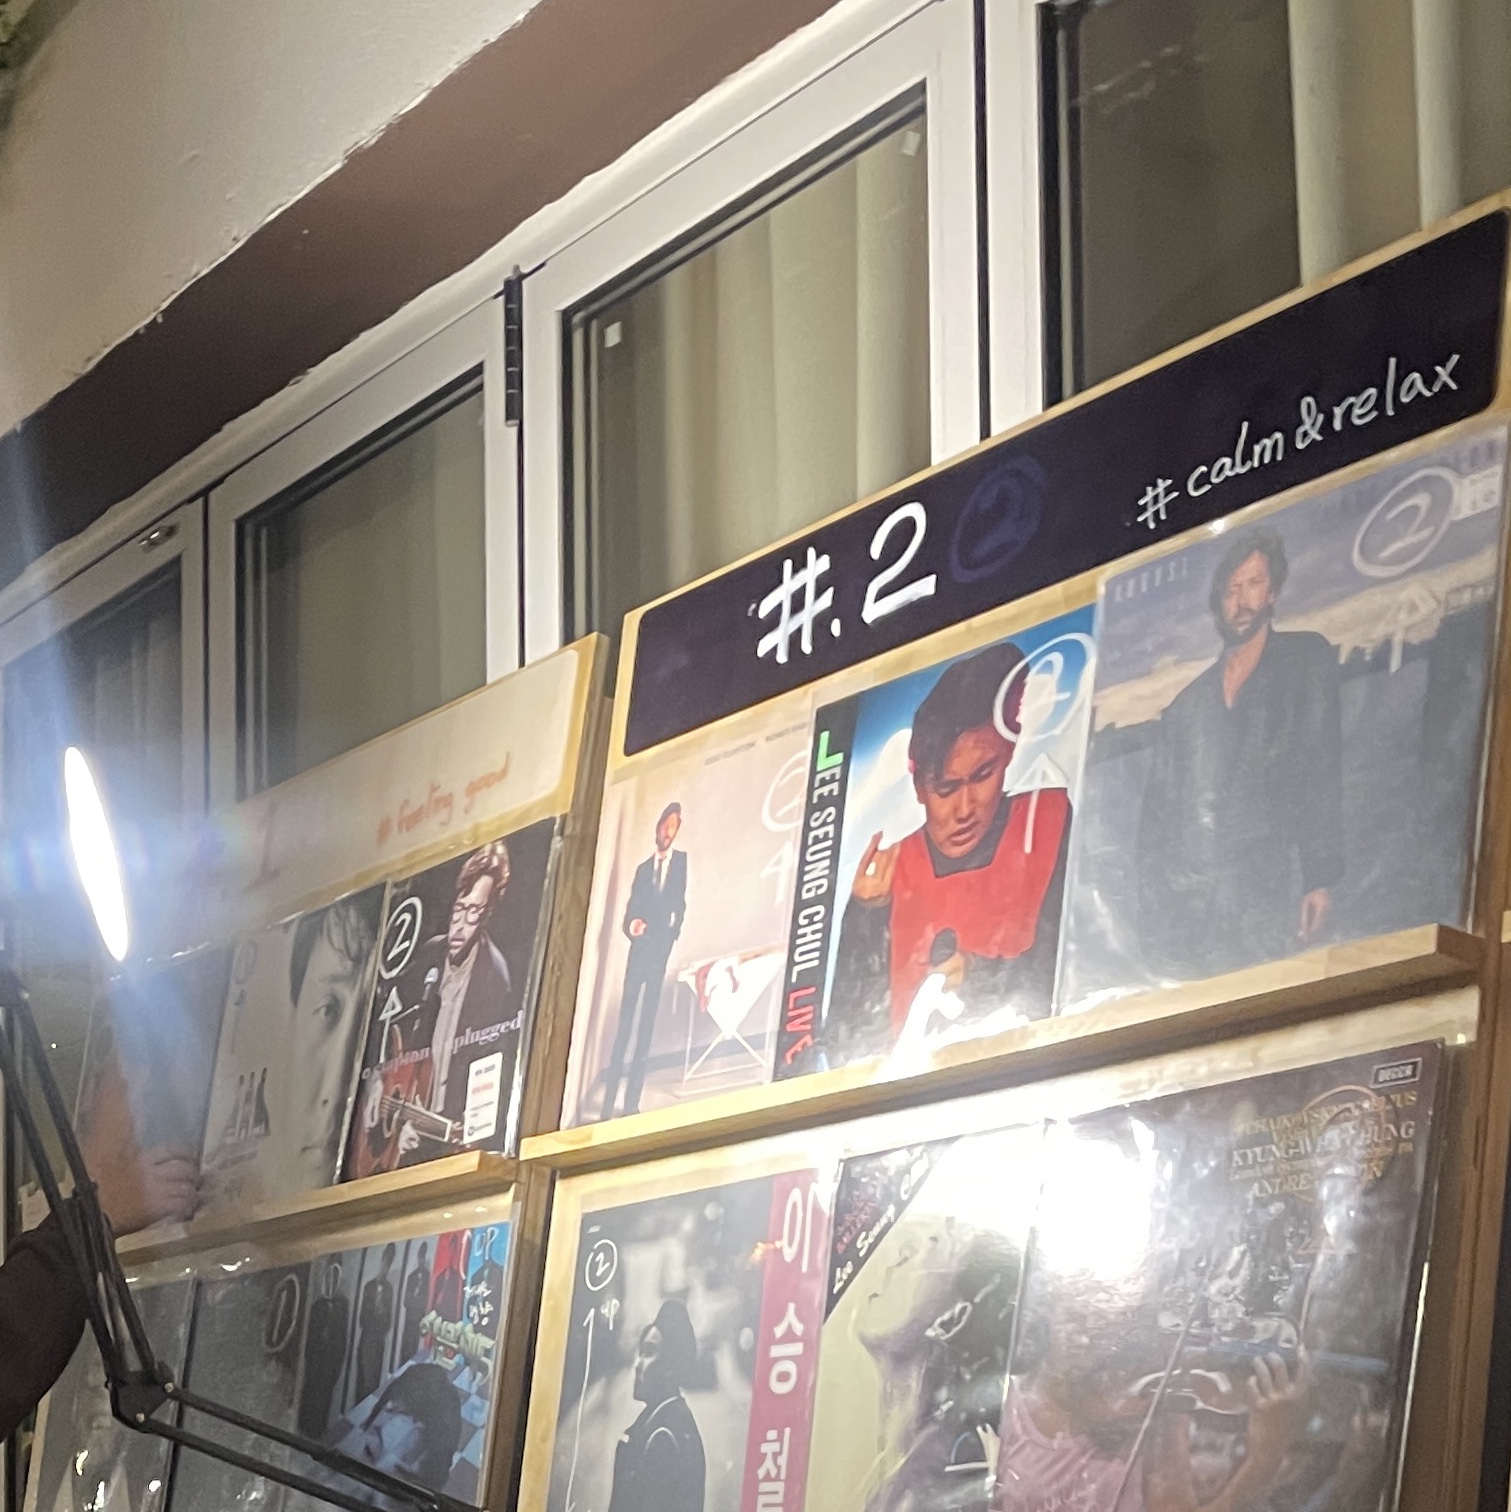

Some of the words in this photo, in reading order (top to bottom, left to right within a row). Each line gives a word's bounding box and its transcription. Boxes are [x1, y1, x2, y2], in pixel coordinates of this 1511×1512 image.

[812, 729, 844, 805] LEE
[800, 805, 837, 901] SEUNG
[790, 903, 826, 985] CHUL
